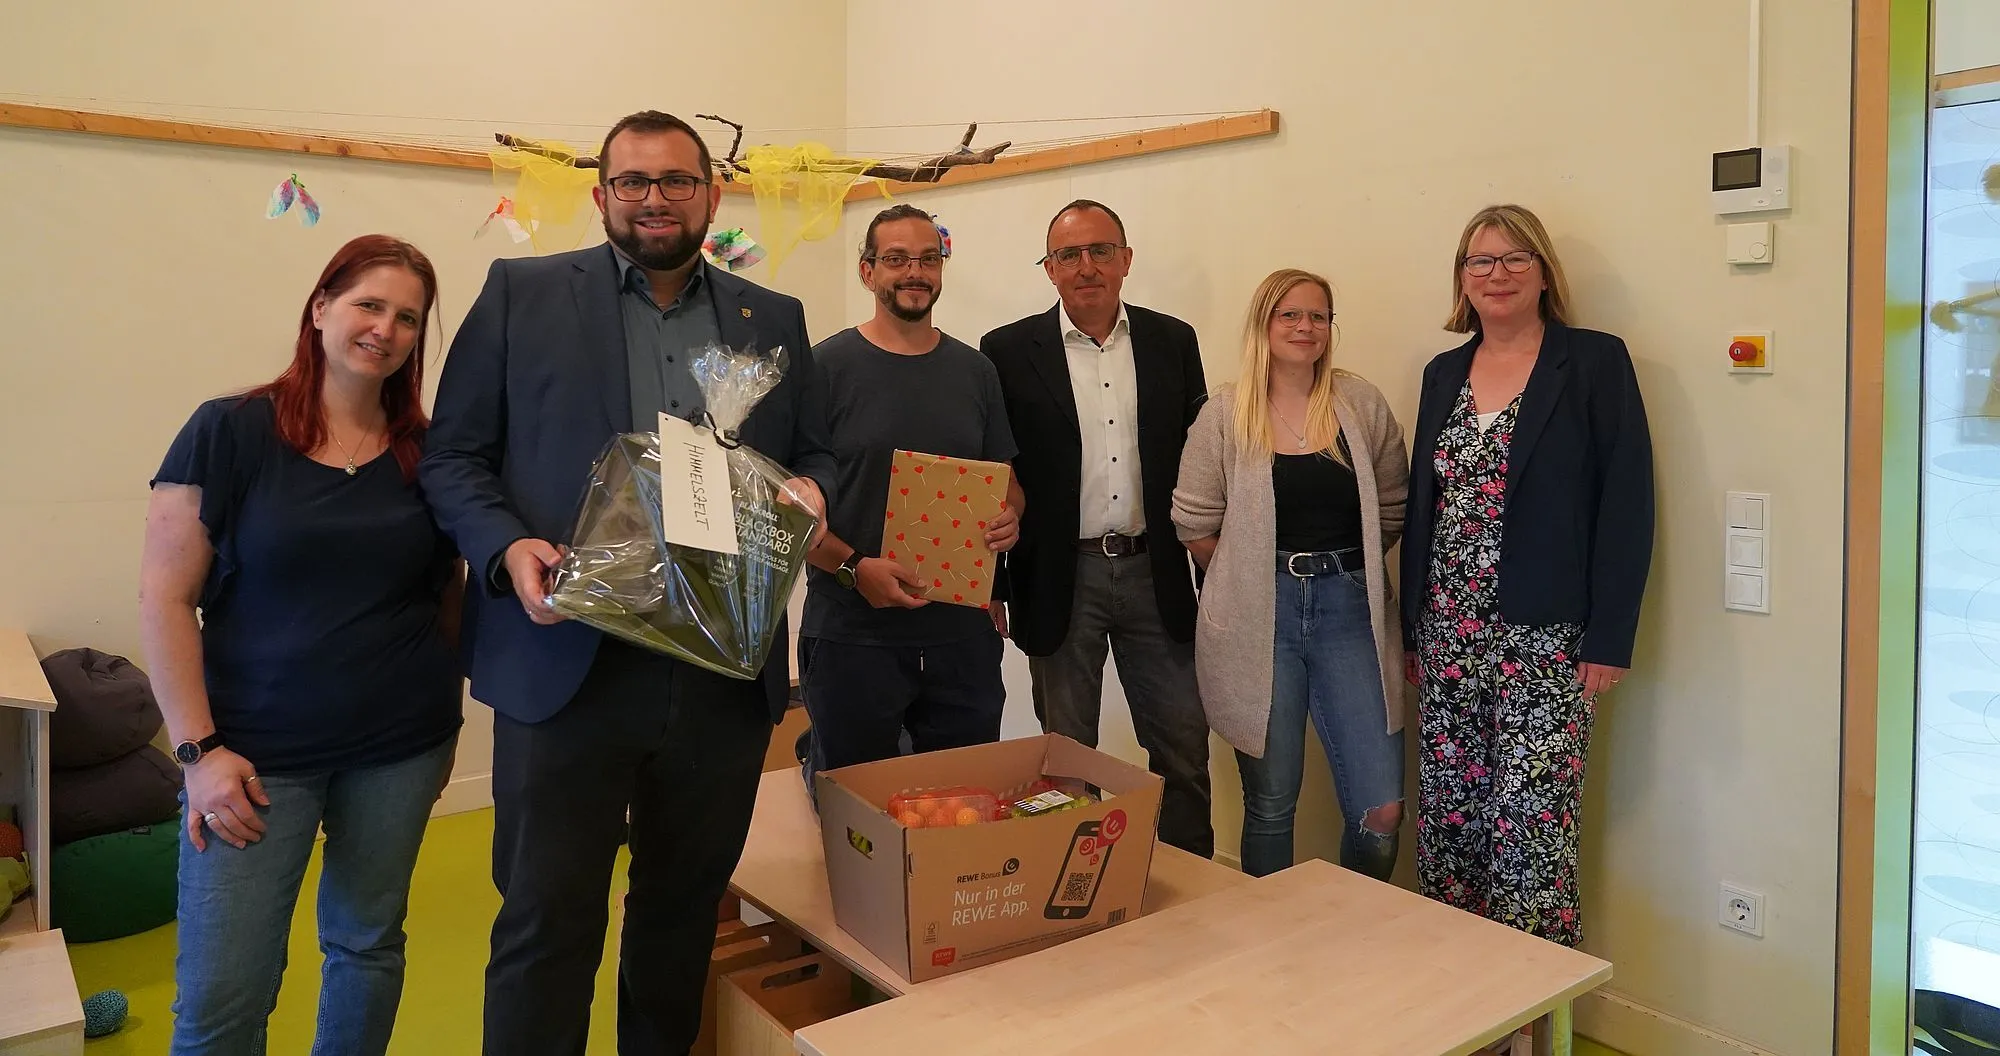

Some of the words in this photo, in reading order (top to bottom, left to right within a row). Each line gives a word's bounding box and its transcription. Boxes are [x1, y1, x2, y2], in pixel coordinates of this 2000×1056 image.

[734, 524, 791, 555] TANDARD
[735, 512, 795, 544] BLACKBOX
[776, 557, 789, 567] FOR
[957, 874, 979, 884] REWE
[980, 872, 1001, 880] Bonus
[954, 890, 981, 907] Nur
[986, 885, 998, 900] in
[1003, 881, 1026, 897] der
[952, 903, 996, 926] REWE
[1000, 901, 1029, 918] App.
